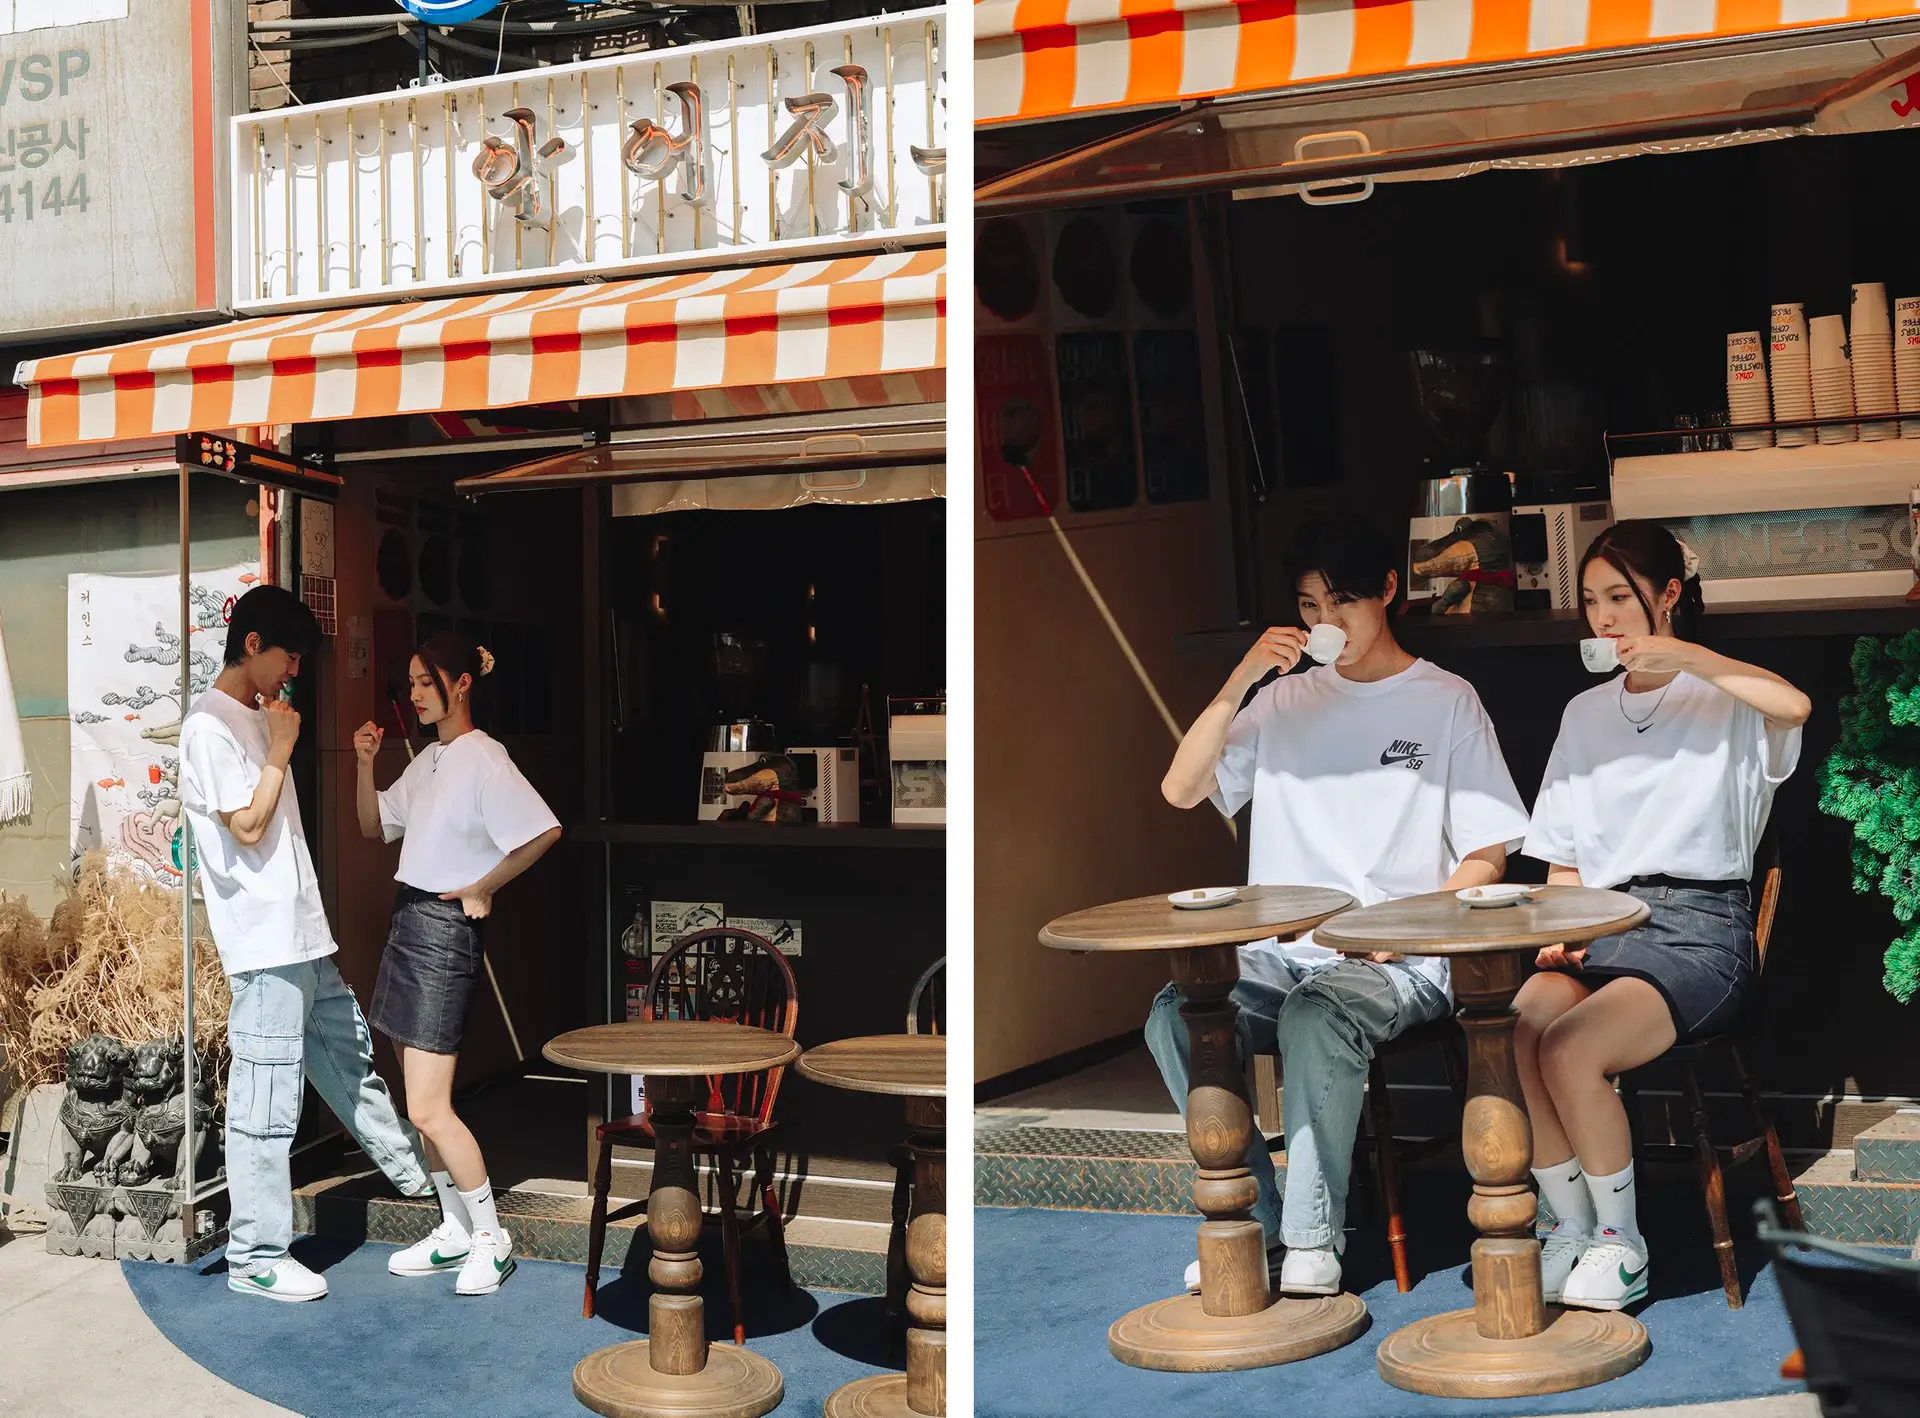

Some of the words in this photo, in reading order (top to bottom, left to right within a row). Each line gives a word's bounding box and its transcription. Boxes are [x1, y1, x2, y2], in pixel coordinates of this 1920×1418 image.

[0, 171, 91, 224] 4144
[1731, 353, 1757, 362] COFFEE
[1730, 362, 1764, 372] ROASTERS
[1388, 739, 1422, 756] NIKE
[1405, 758, 1424, 771] SB
